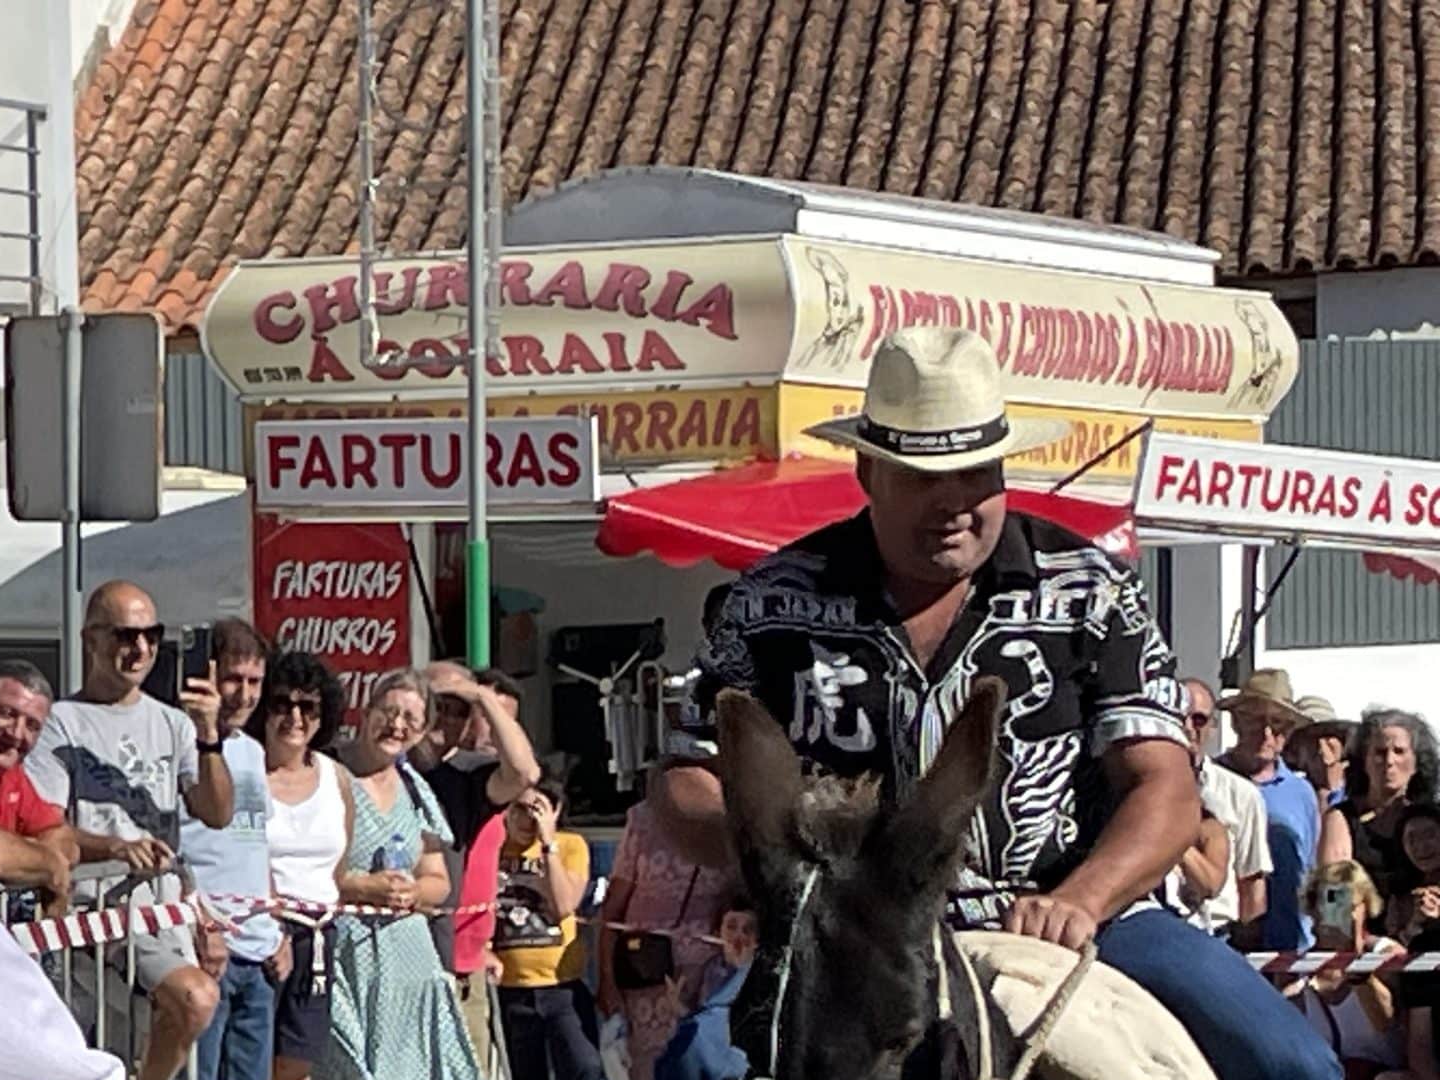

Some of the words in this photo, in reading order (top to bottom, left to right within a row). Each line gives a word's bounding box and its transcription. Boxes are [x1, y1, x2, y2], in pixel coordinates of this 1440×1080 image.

[254, 261, 738, 340] CHURRARIA
[267, 431, 581, 489] FARTURAS
[1156, 455, 1363, 519] FARTURAS
[272, 560, 402, 600] FARTURAS
[277, 615, 396, 655] CHURROS
